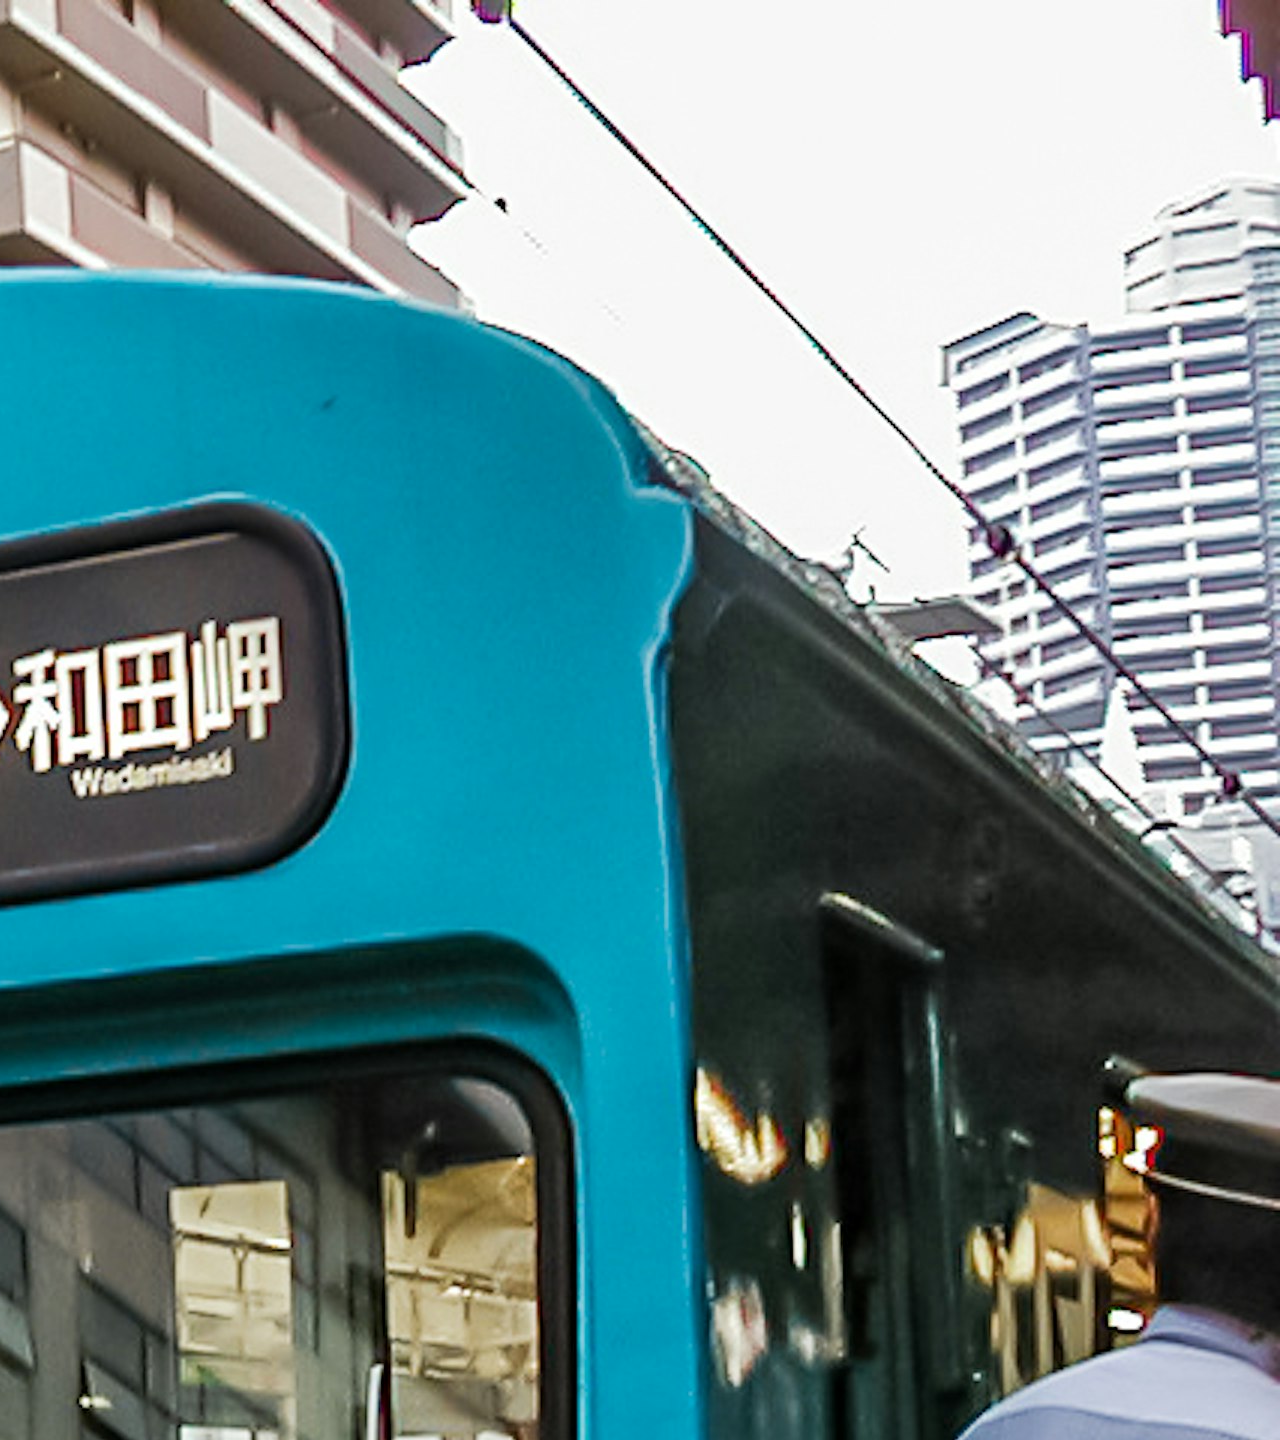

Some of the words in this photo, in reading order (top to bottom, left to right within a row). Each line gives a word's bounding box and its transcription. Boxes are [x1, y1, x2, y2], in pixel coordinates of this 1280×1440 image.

[12, 616, 282, 772] 和田岬
[72, 747, 234, 797] Wadamisaki
